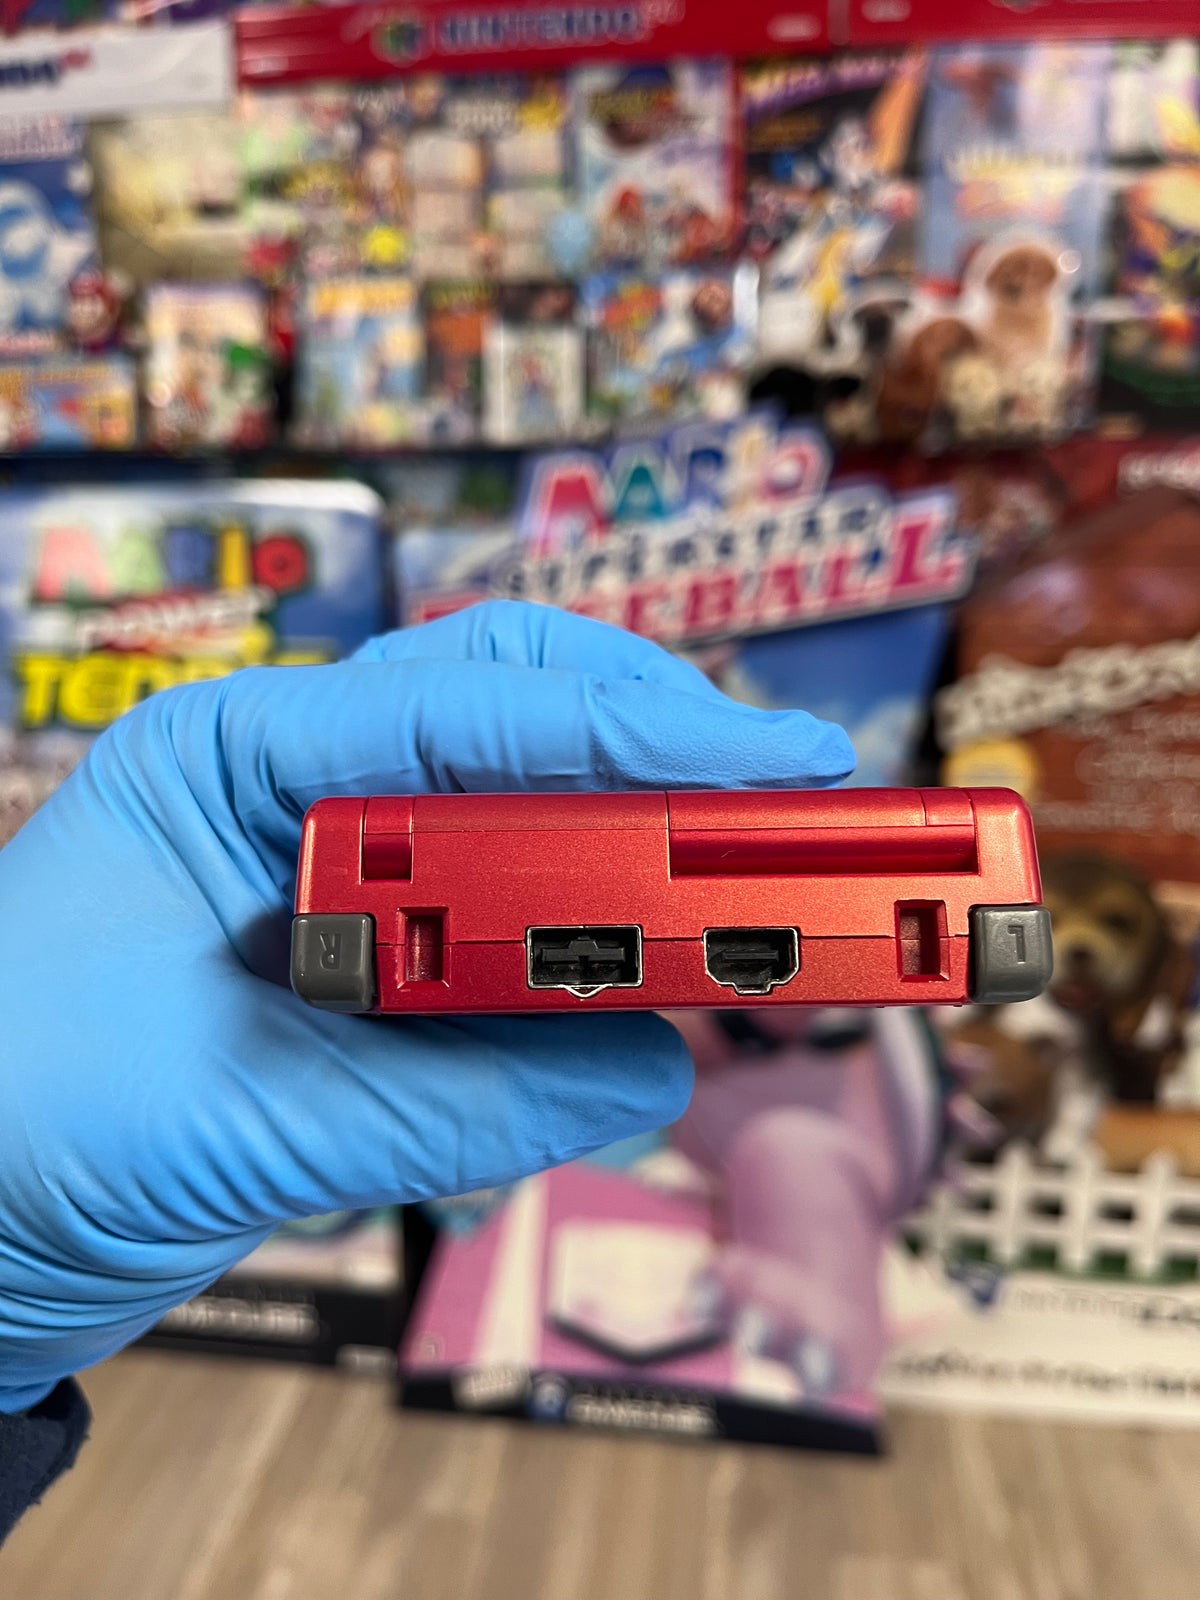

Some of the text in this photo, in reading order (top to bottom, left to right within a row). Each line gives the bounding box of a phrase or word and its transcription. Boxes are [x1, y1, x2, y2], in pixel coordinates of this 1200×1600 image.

[533, 428, 834, 553] MARIO
[34, 524, 310, 604] MARIO
[319, 931, 342, 970] R
[1006, 924, 1026, 964] L
